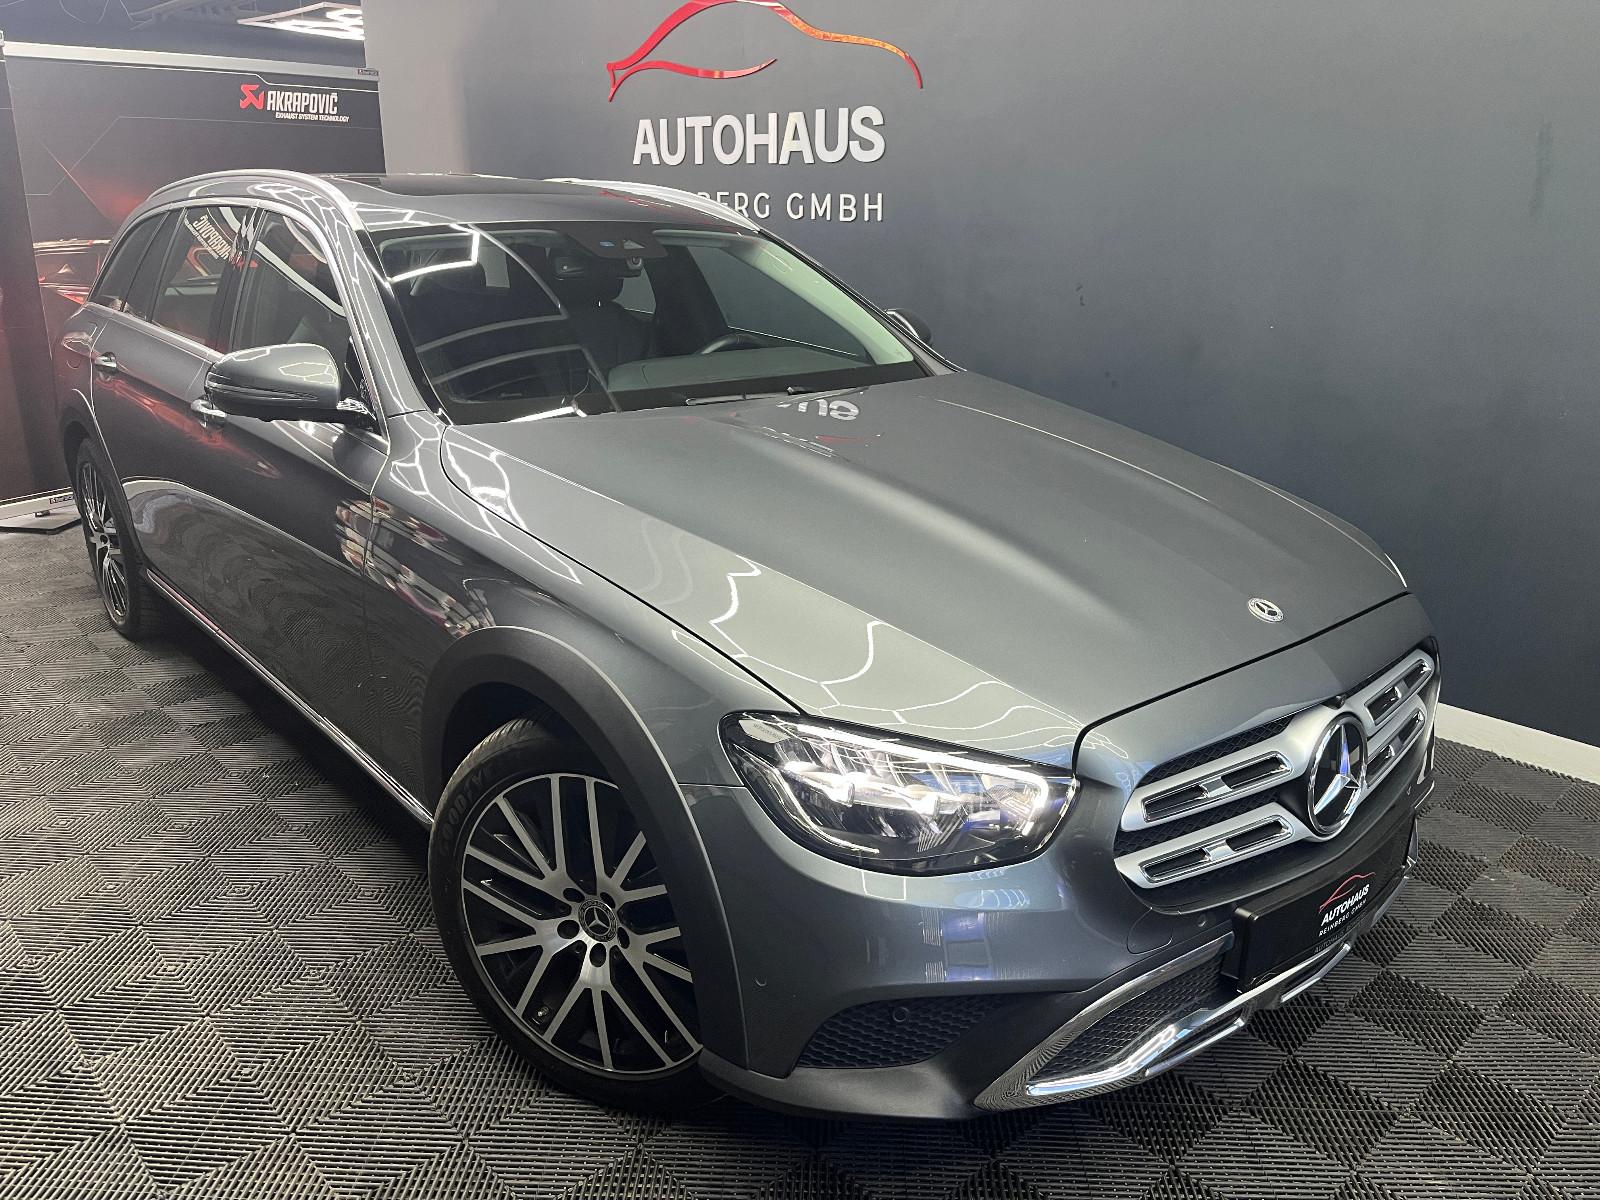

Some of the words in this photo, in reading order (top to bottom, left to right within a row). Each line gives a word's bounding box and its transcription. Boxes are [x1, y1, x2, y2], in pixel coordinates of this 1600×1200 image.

[266, 90, 339, 115] AKRAPOVIČ
[275, 111, 299, 120] EXHAUST
[298, 113, 319, 121] SYSTEM
[318, 114, 350, 123] TECHNOLOGY
[633, 105, 886, 166] AUTOHAUS
[786, 191, 883, 223] GMBH
[1320, 883, 1370, 927] AUTOHAUS
